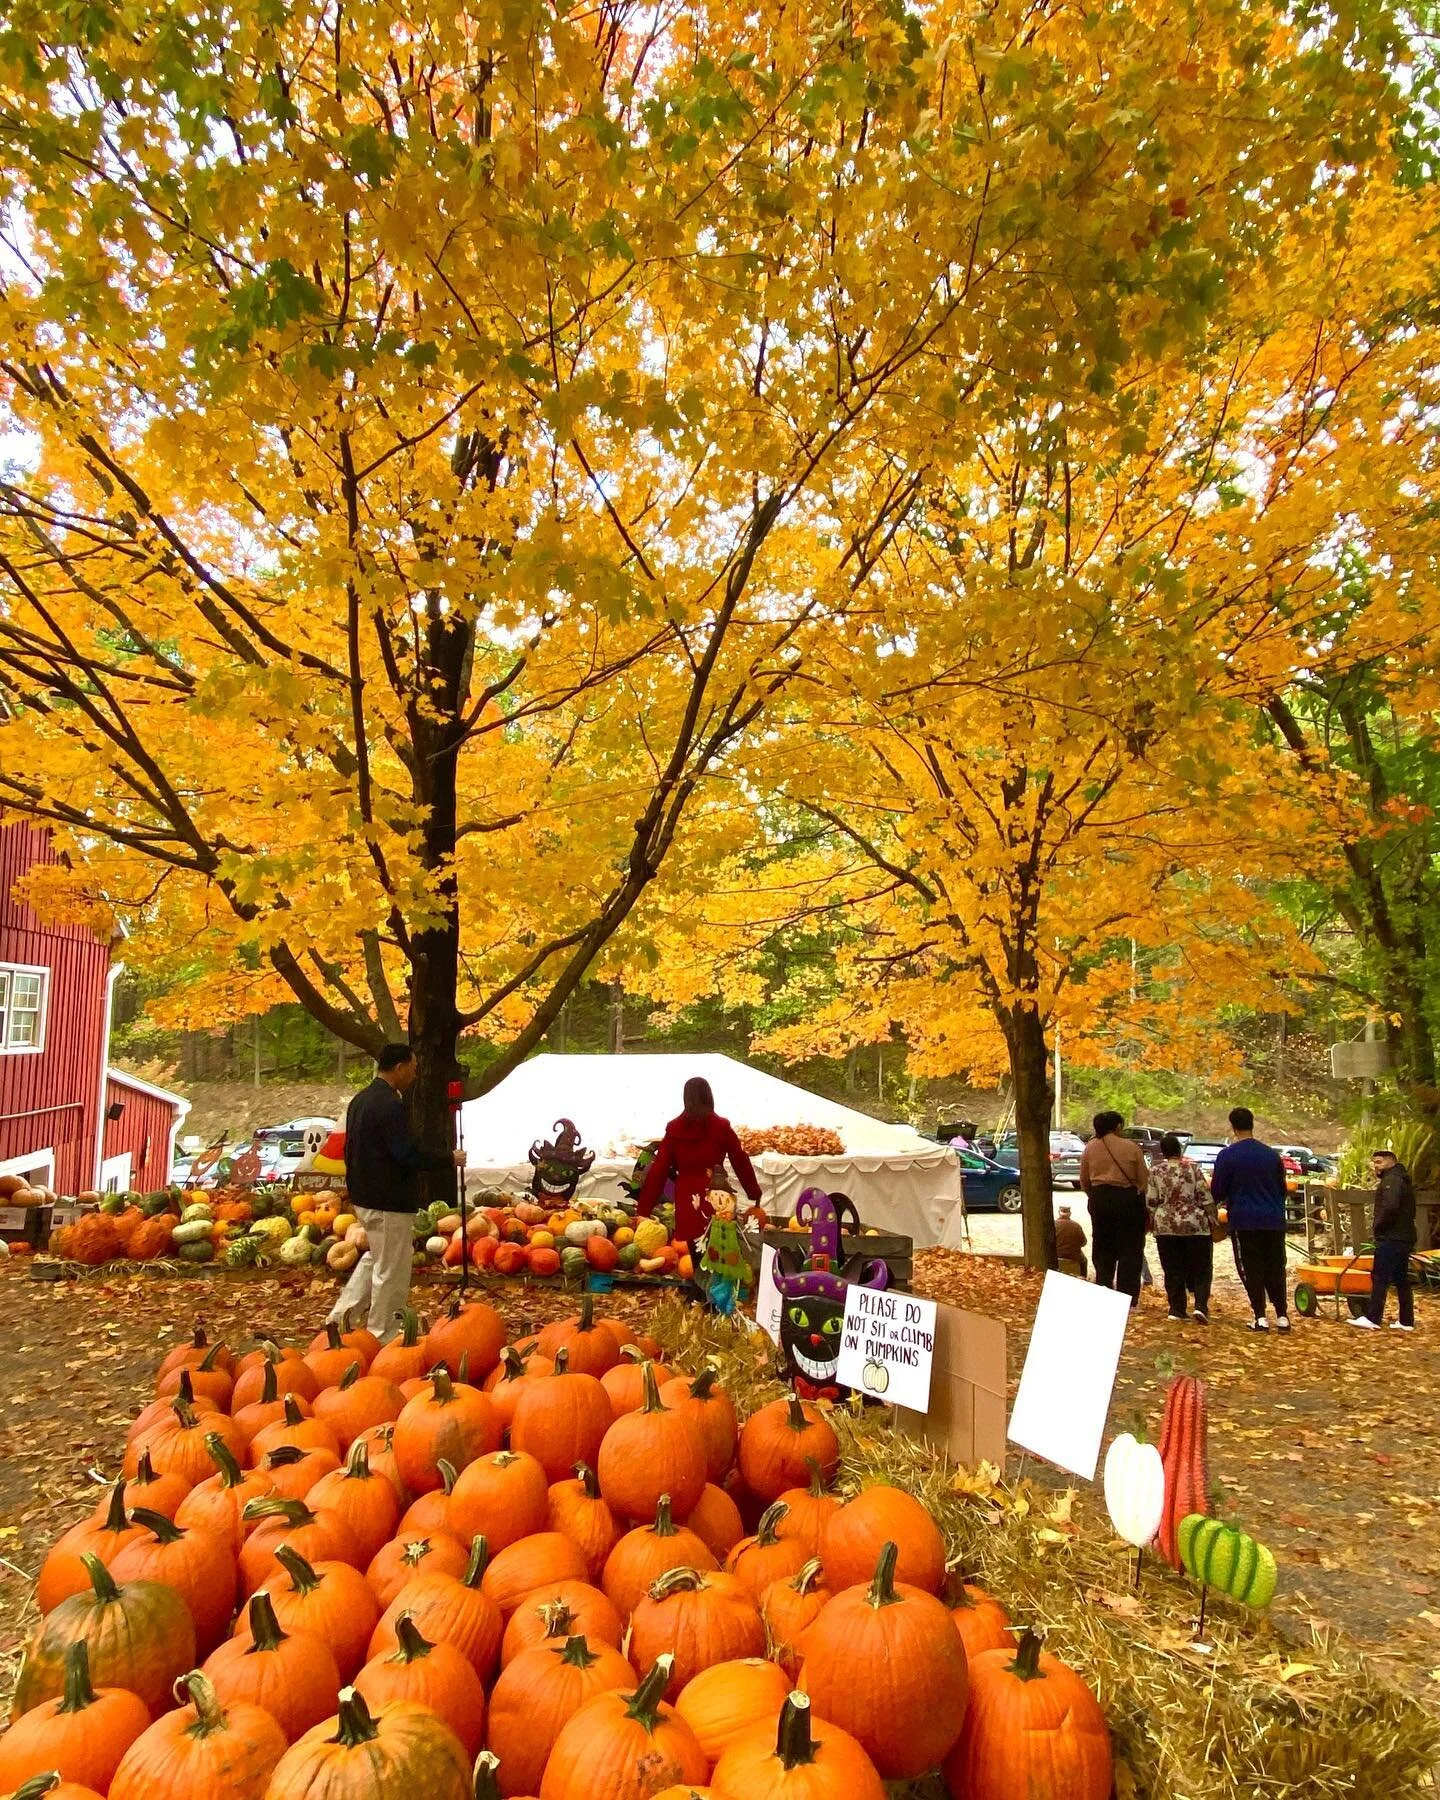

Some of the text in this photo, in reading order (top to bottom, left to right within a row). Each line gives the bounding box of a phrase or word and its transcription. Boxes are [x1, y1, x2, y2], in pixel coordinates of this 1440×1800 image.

[859, 1293, 921, 1323] PLEASE DO
[846, 1315, 933, 1352] NOT SIT OR CLIMB
[845, 1335, 920, 1366] ON PUMPKINS
